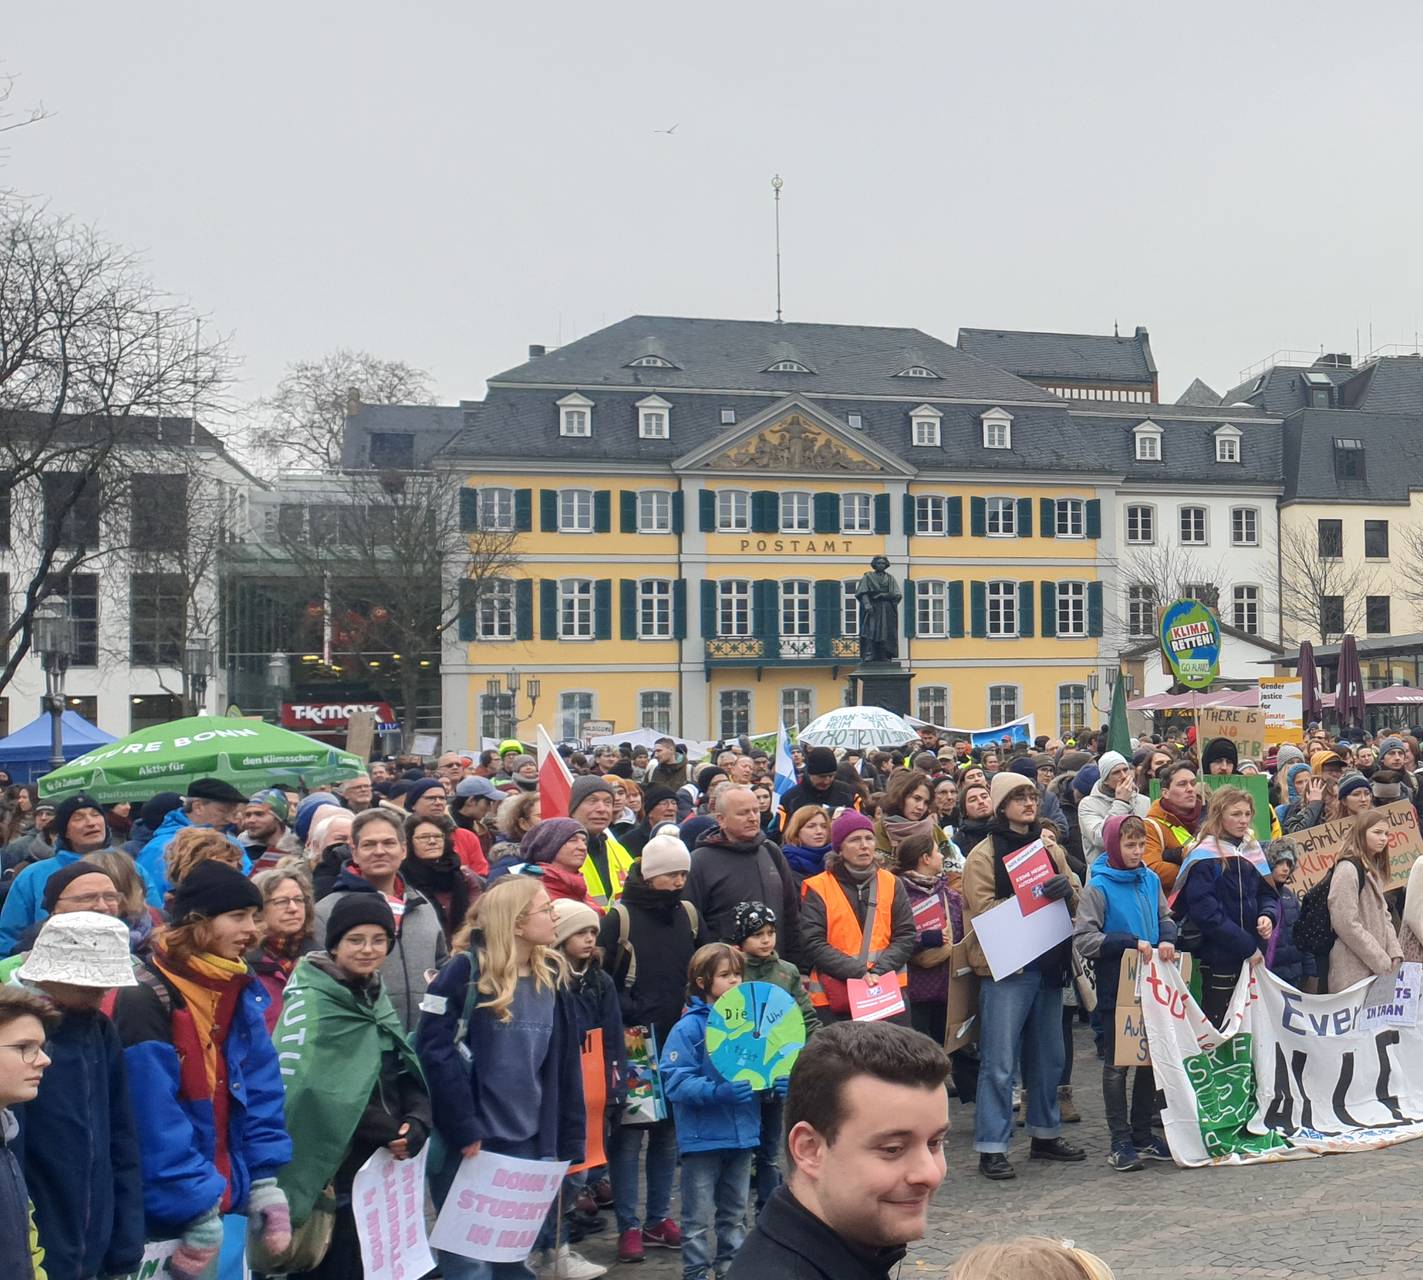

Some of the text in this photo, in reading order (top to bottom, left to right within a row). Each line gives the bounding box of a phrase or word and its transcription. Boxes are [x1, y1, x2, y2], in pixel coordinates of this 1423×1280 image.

[740, 540, 853, 552] POSTAMT
[1172, 622, 1208, 639] KLIMA
[1172, 634, 1214, 652] RETTEN!
[1204, 708, 1239, 722] THERE
[173, 728, 258, 746] BONN
[1219, 725, 1238, 737] NO
[1252, 740, 1260, 757] B
[243, 753, 319, 765] den Klimaschutz
[138, 762, 185, 776] Aktiv für
[725, 1008, 784, 1024] Die Uhr
[491, 1168, 547, 1192] BONN
[457, 1189, 549, 1220] STUDENT
[466, 1223, 537, 1248] IN IRA
